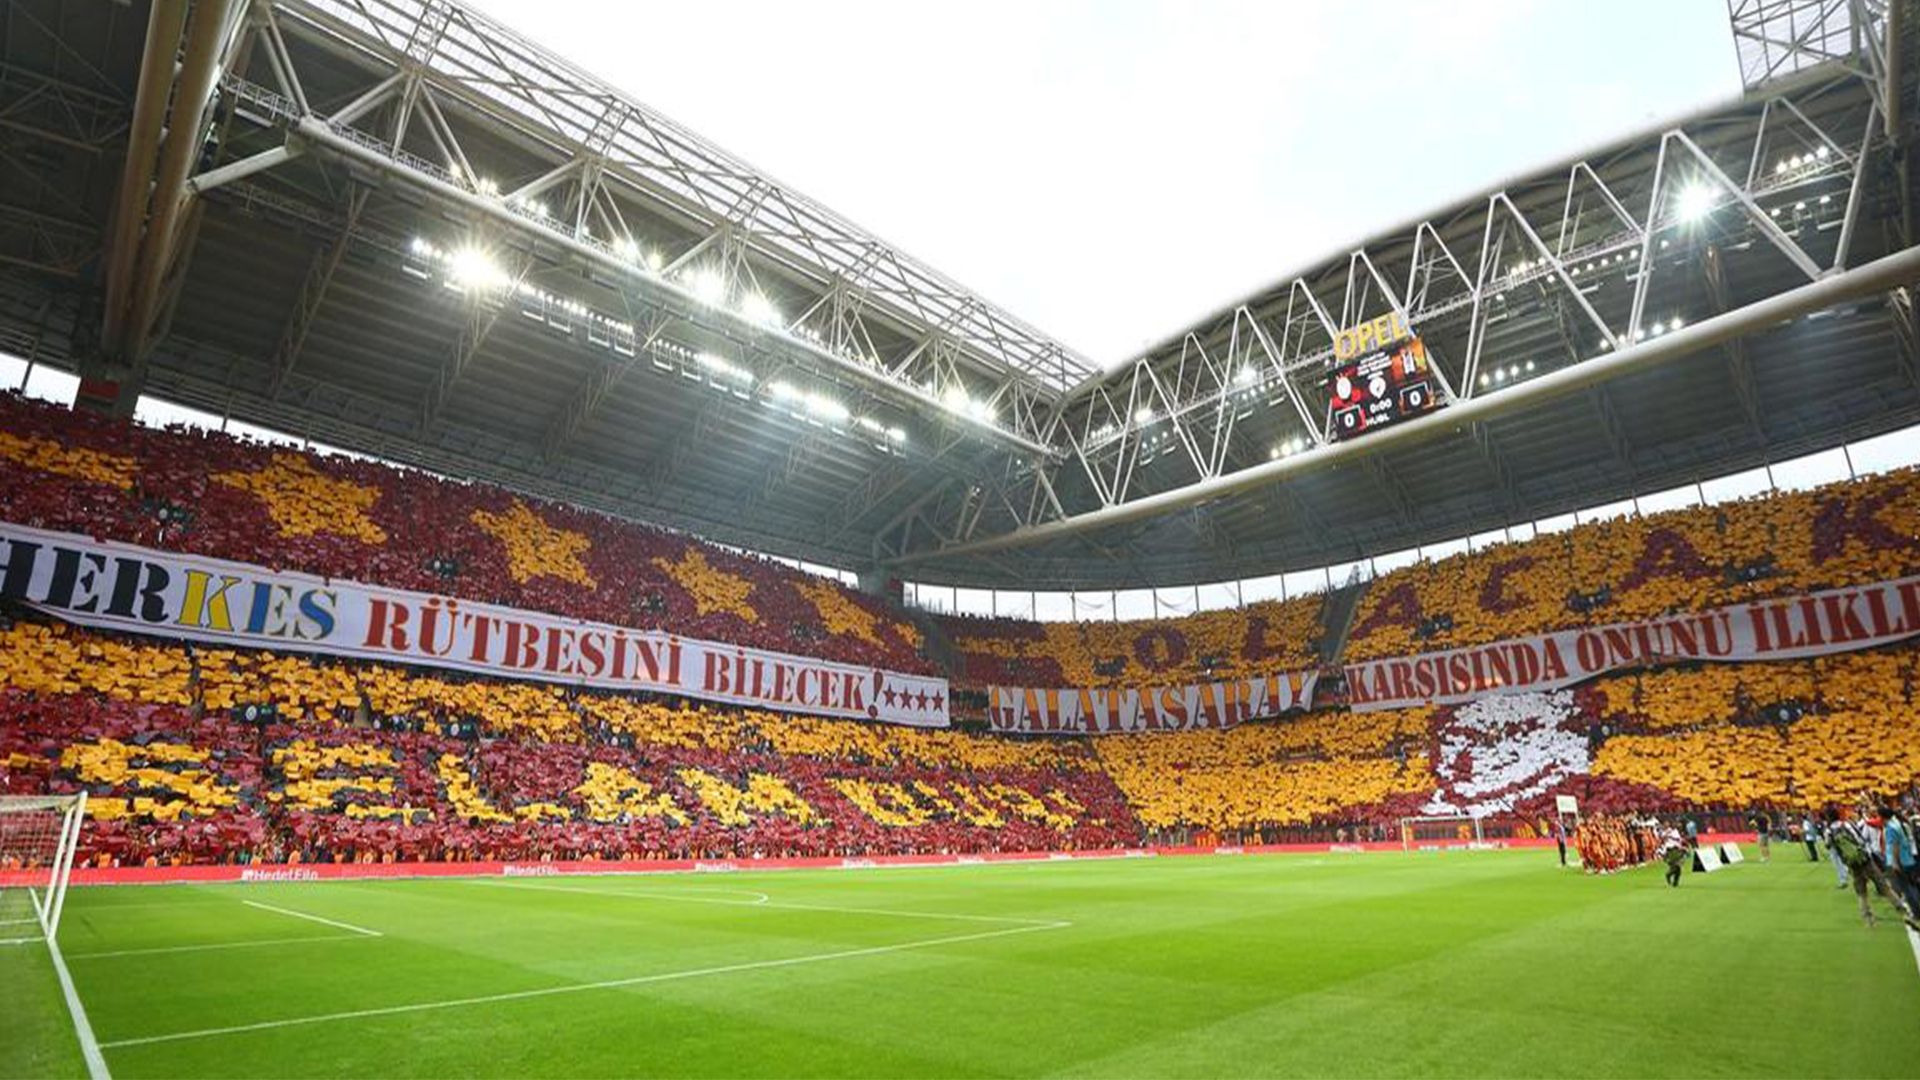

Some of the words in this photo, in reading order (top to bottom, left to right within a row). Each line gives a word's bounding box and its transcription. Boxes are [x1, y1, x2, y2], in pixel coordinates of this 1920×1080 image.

[1334, 311, 1407, 359] OPEL
[1344, 413, 1354, 427] 0
[1410, 391, 1420, 406] 0
[0, 537, 337, 640] HERKES
[362, 597, 682, 685] RÜTBESİNİ
[703, 649, 884, 719] BİLECEK!
[989, 671, 1317, 731] GALATASARAY
